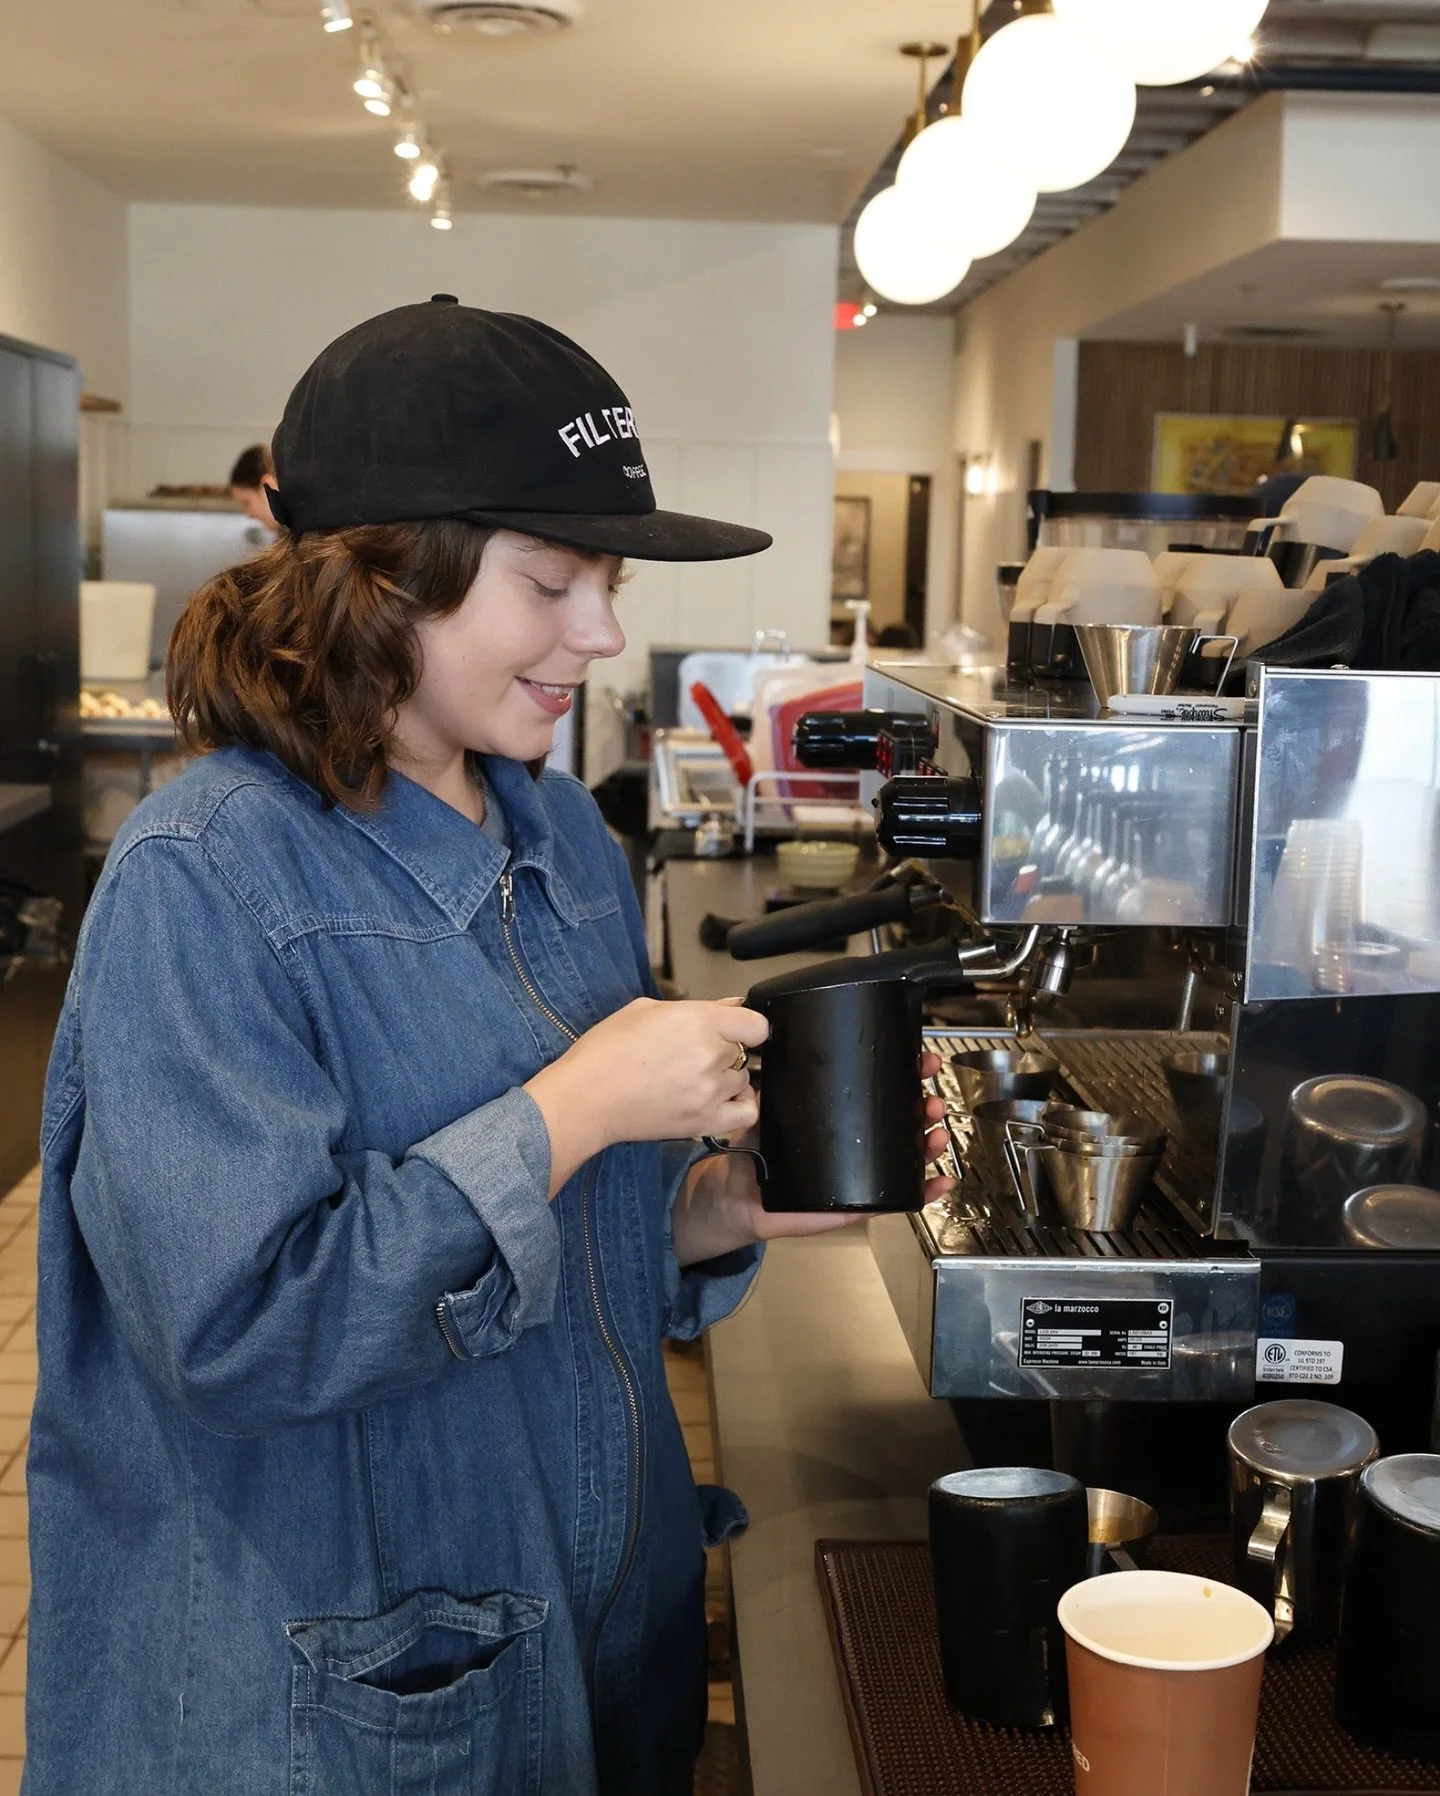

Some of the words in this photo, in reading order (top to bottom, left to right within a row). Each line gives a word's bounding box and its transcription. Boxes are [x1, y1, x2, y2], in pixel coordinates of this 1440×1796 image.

[558, 406, 639, 458] FILTER
[1054, 1304, 1062, 1313] la
[1063, 1305, 1100, 1313] marzocco
